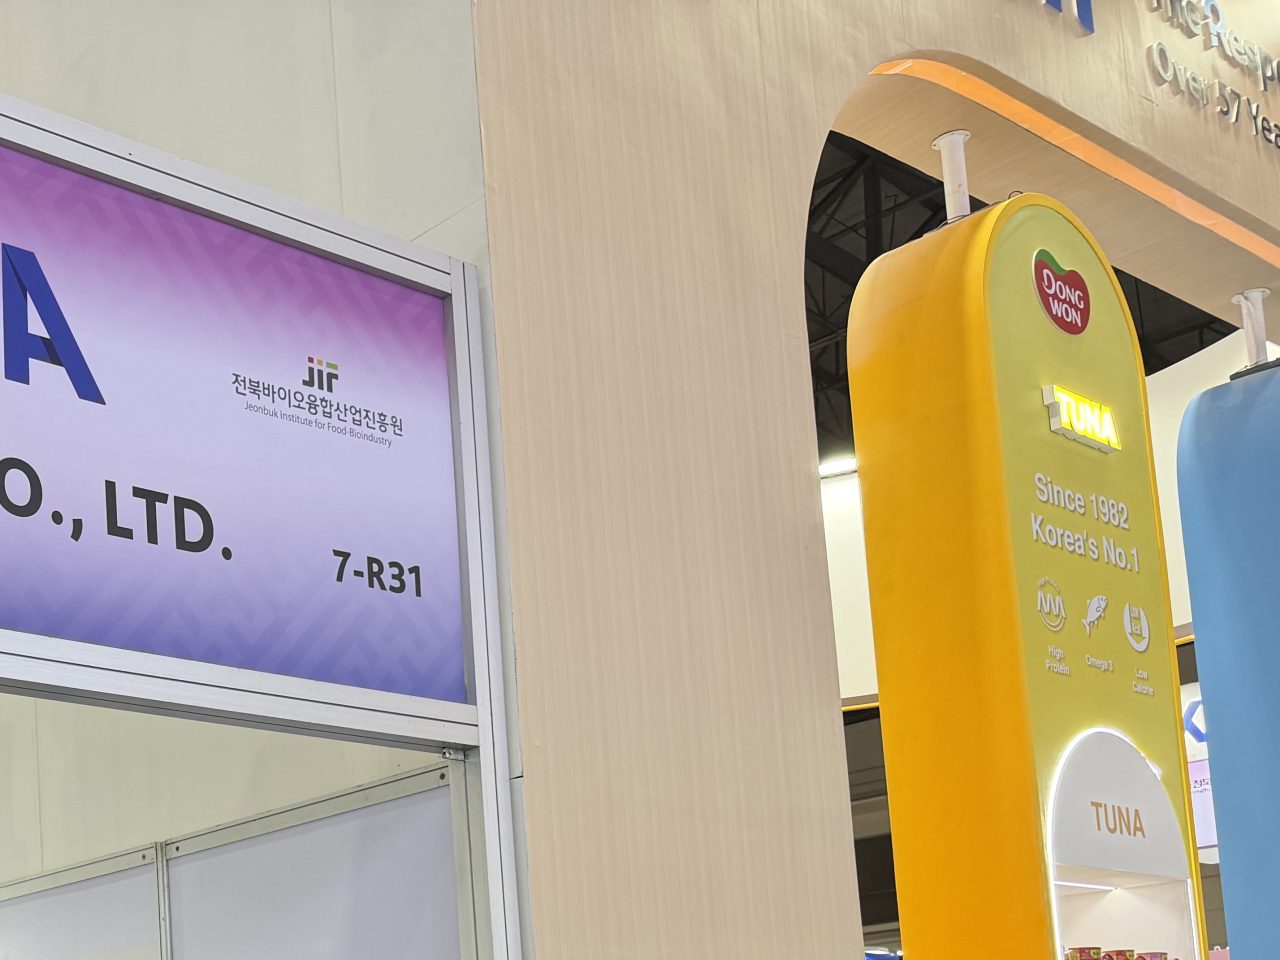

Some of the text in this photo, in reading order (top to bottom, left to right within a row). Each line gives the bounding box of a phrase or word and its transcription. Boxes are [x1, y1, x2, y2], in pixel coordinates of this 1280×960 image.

[1152, 41, 1209, 105] Over
[1042, 268, 1085, 309] DONG
[1049, 297, 1082, 328] WON
[231, 372, 403, 437] 전북바이오융합산업진흥원
[245, 401, 393, 449] Jeonbuk Institute for Food-Bioindustry
[1052, 385, 1122, 451] TUNA
[104, 479, 234, 561] LTD.
[1035, 472, 1130, 531] Since 1982
[1031, 512, 1140, 573] Korea's No.1
[332, 549, 424, 599] 7-R31
[1045, 660, 1071, 676] Protein
[1048, 645, 1065, 662] High
[1085, 654, 1109, 671] Omega
[1135, 667, 1148, 680] Low
[1090, 800, 1146, 839] TUNA
